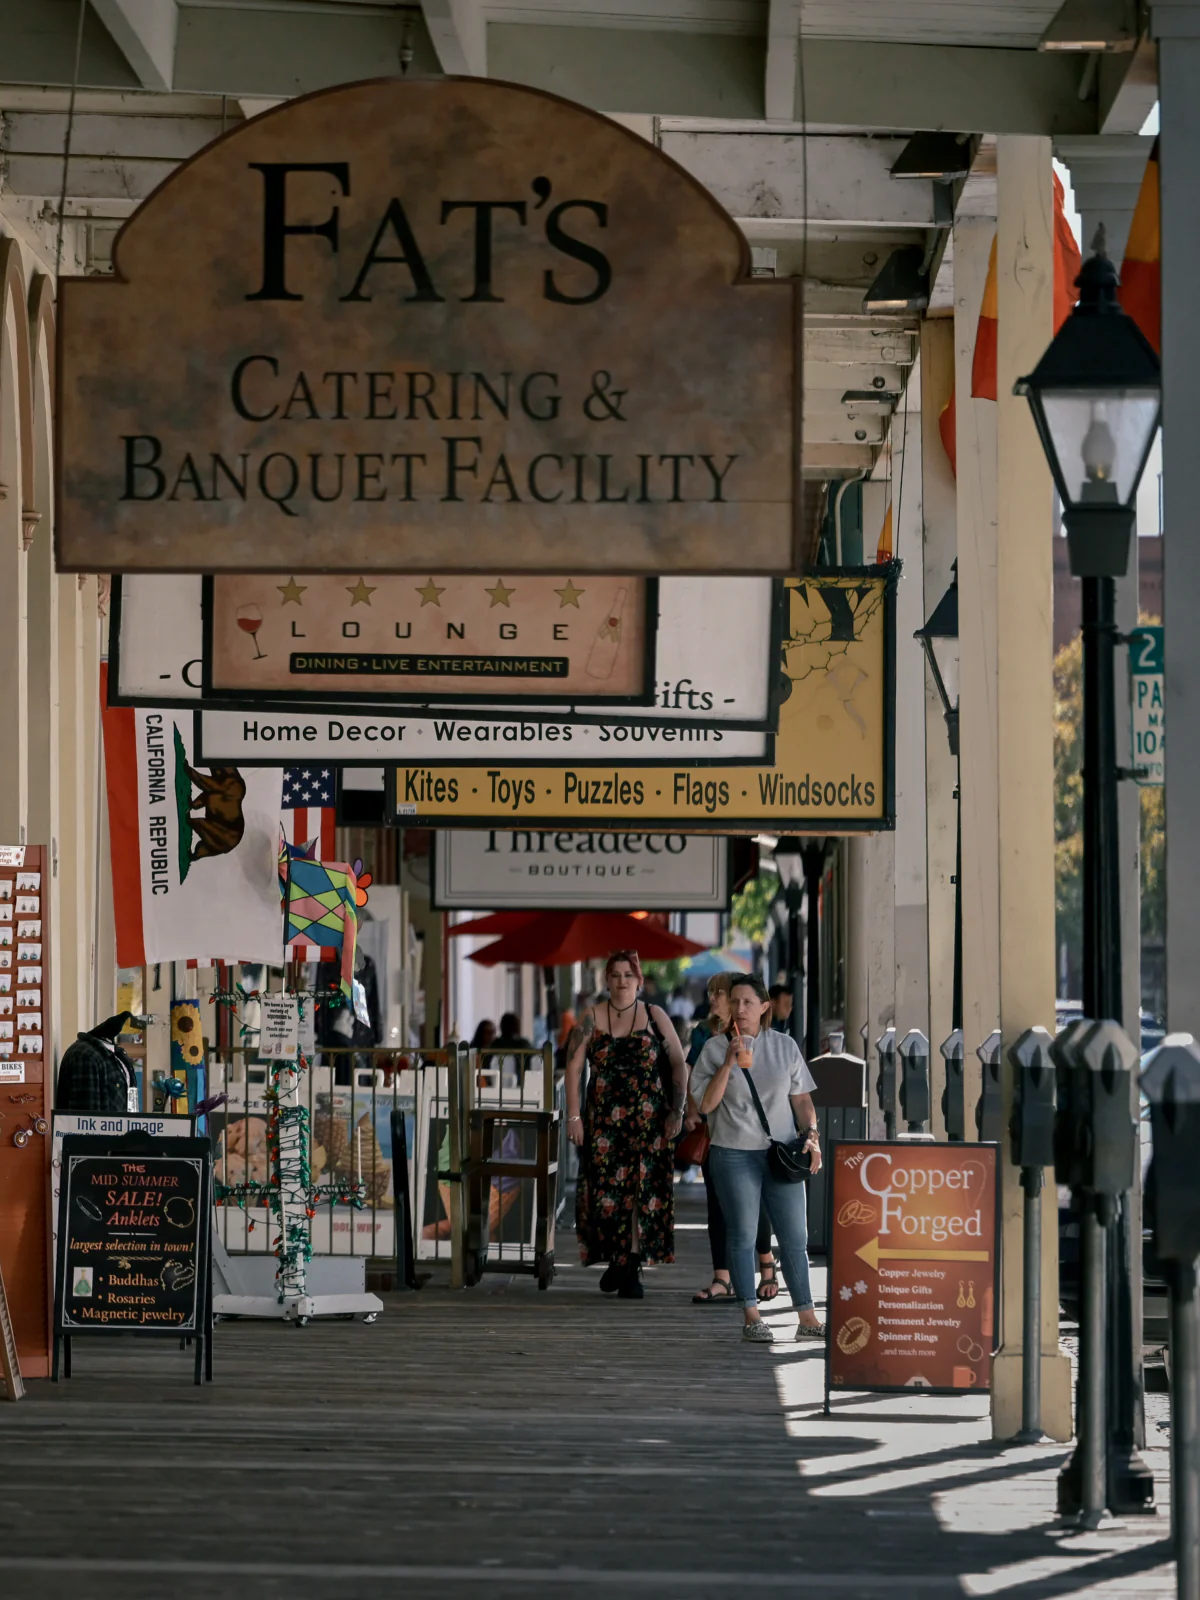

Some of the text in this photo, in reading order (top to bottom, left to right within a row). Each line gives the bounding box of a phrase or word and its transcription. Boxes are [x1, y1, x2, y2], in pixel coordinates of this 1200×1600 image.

[244, 162, 612, 305] FAT'S
[231, 354, 629, 422] CATERING &
[118, 435, 739, 517] BANQUET FACILITY
[291, 620, 569, 641] LOUNGE
[295, 657, 564, 673] DINING LIVE ENTERTAINMENT
[654, 679, 713, 711] ifts
[243, 721, 318, 741] Home
[328, 721, 406, 741] Decor
[434, 721, 573, 741] Wearables
[146, 714, 166, 805] CALIFORNIA
[405, 769, 875, 813] Kites Toys Puzzles Flags Windsocks
[149, 816, 169, 896] REPUBLIC
[528, 865, 636, 877] BOUTIQUE
[77, 1118, 164, 1134] Ink and Image
[121, 1164, 146, 1173] THE
[844, 1152, 865, 1169] The
[91, 1175, 180, 1187] MID SUMMER
[860, 1153, 974, 1196] Copper
[105, 1190, 163, 1207] SALE!
[106, 1210, 161, 1227] Anklets
[878, 1193, 982, 1242] Forged
[69, 1238, 194, 1253] largest selection in town!
[108, 1274, 159, 1287] Buddhas
[878, 1268, 946, 1279] Copper Jewelry
[878, 1285, 933, 1295] Unique Gifts
[107, 1292, 156, 1305] Rosaries
[878, 1300, 944, 1310] Personalization
[82, 1307, 185, 1323] Magnetic jewelry
[877, 1316, 962, 1328] Permanent Jewelry
[877, 1332, 938, 1343] Spinner Rings
[898, 1348, 917, 1356] much
